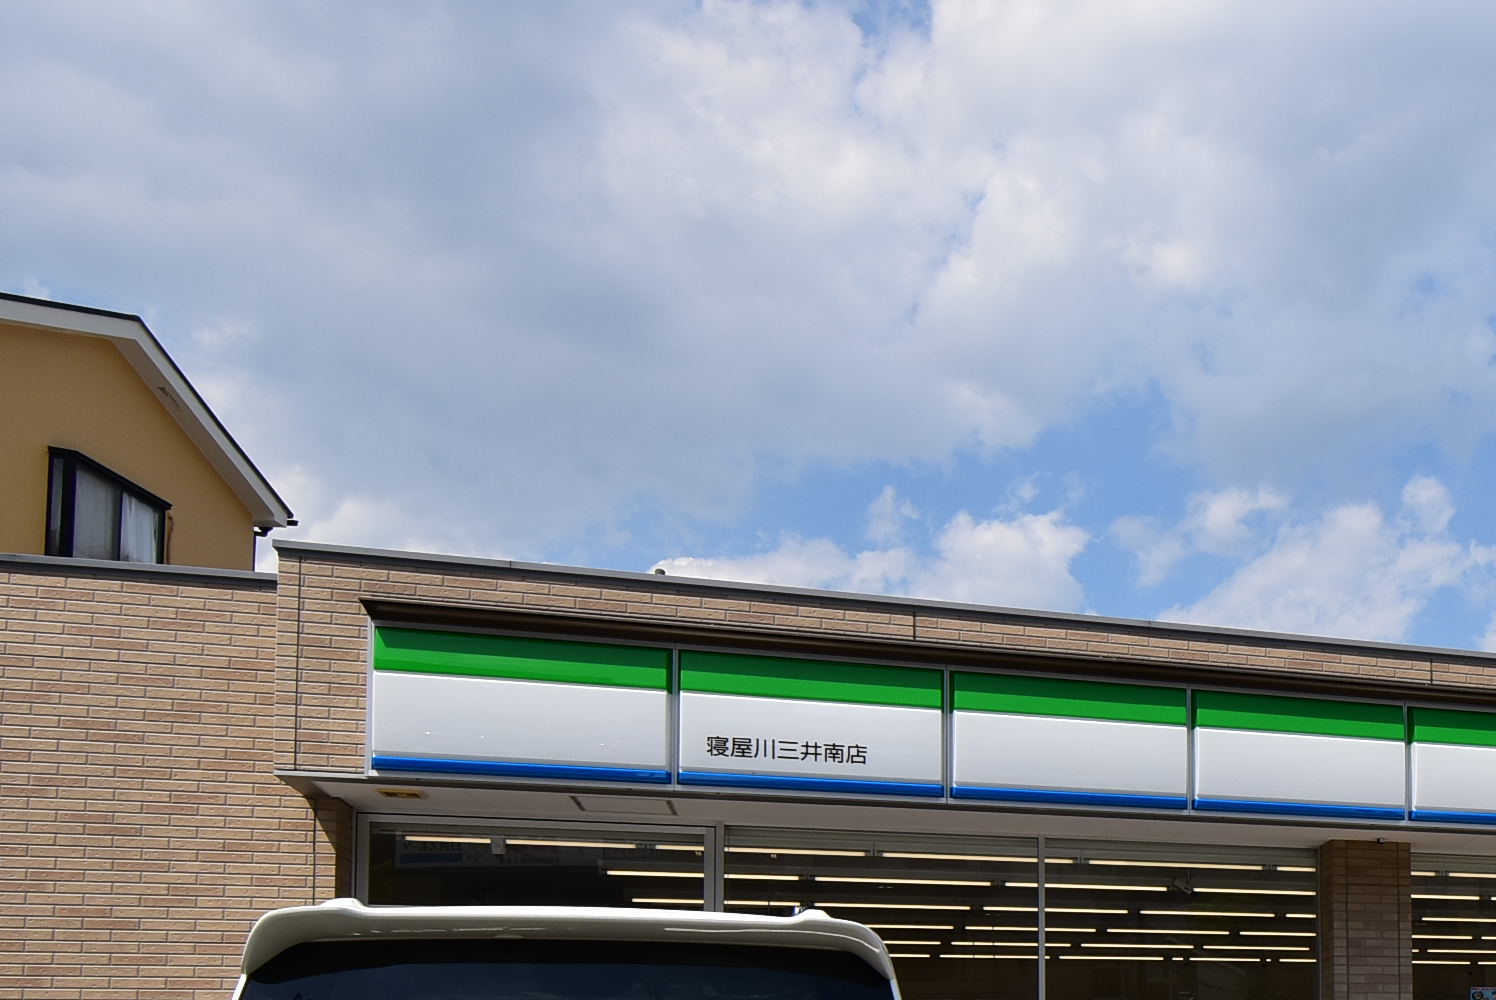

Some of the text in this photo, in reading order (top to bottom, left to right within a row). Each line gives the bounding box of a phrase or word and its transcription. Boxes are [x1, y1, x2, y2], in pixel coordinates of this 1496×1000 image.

[706, 736, 868, 765] 寝屋川三井南店
